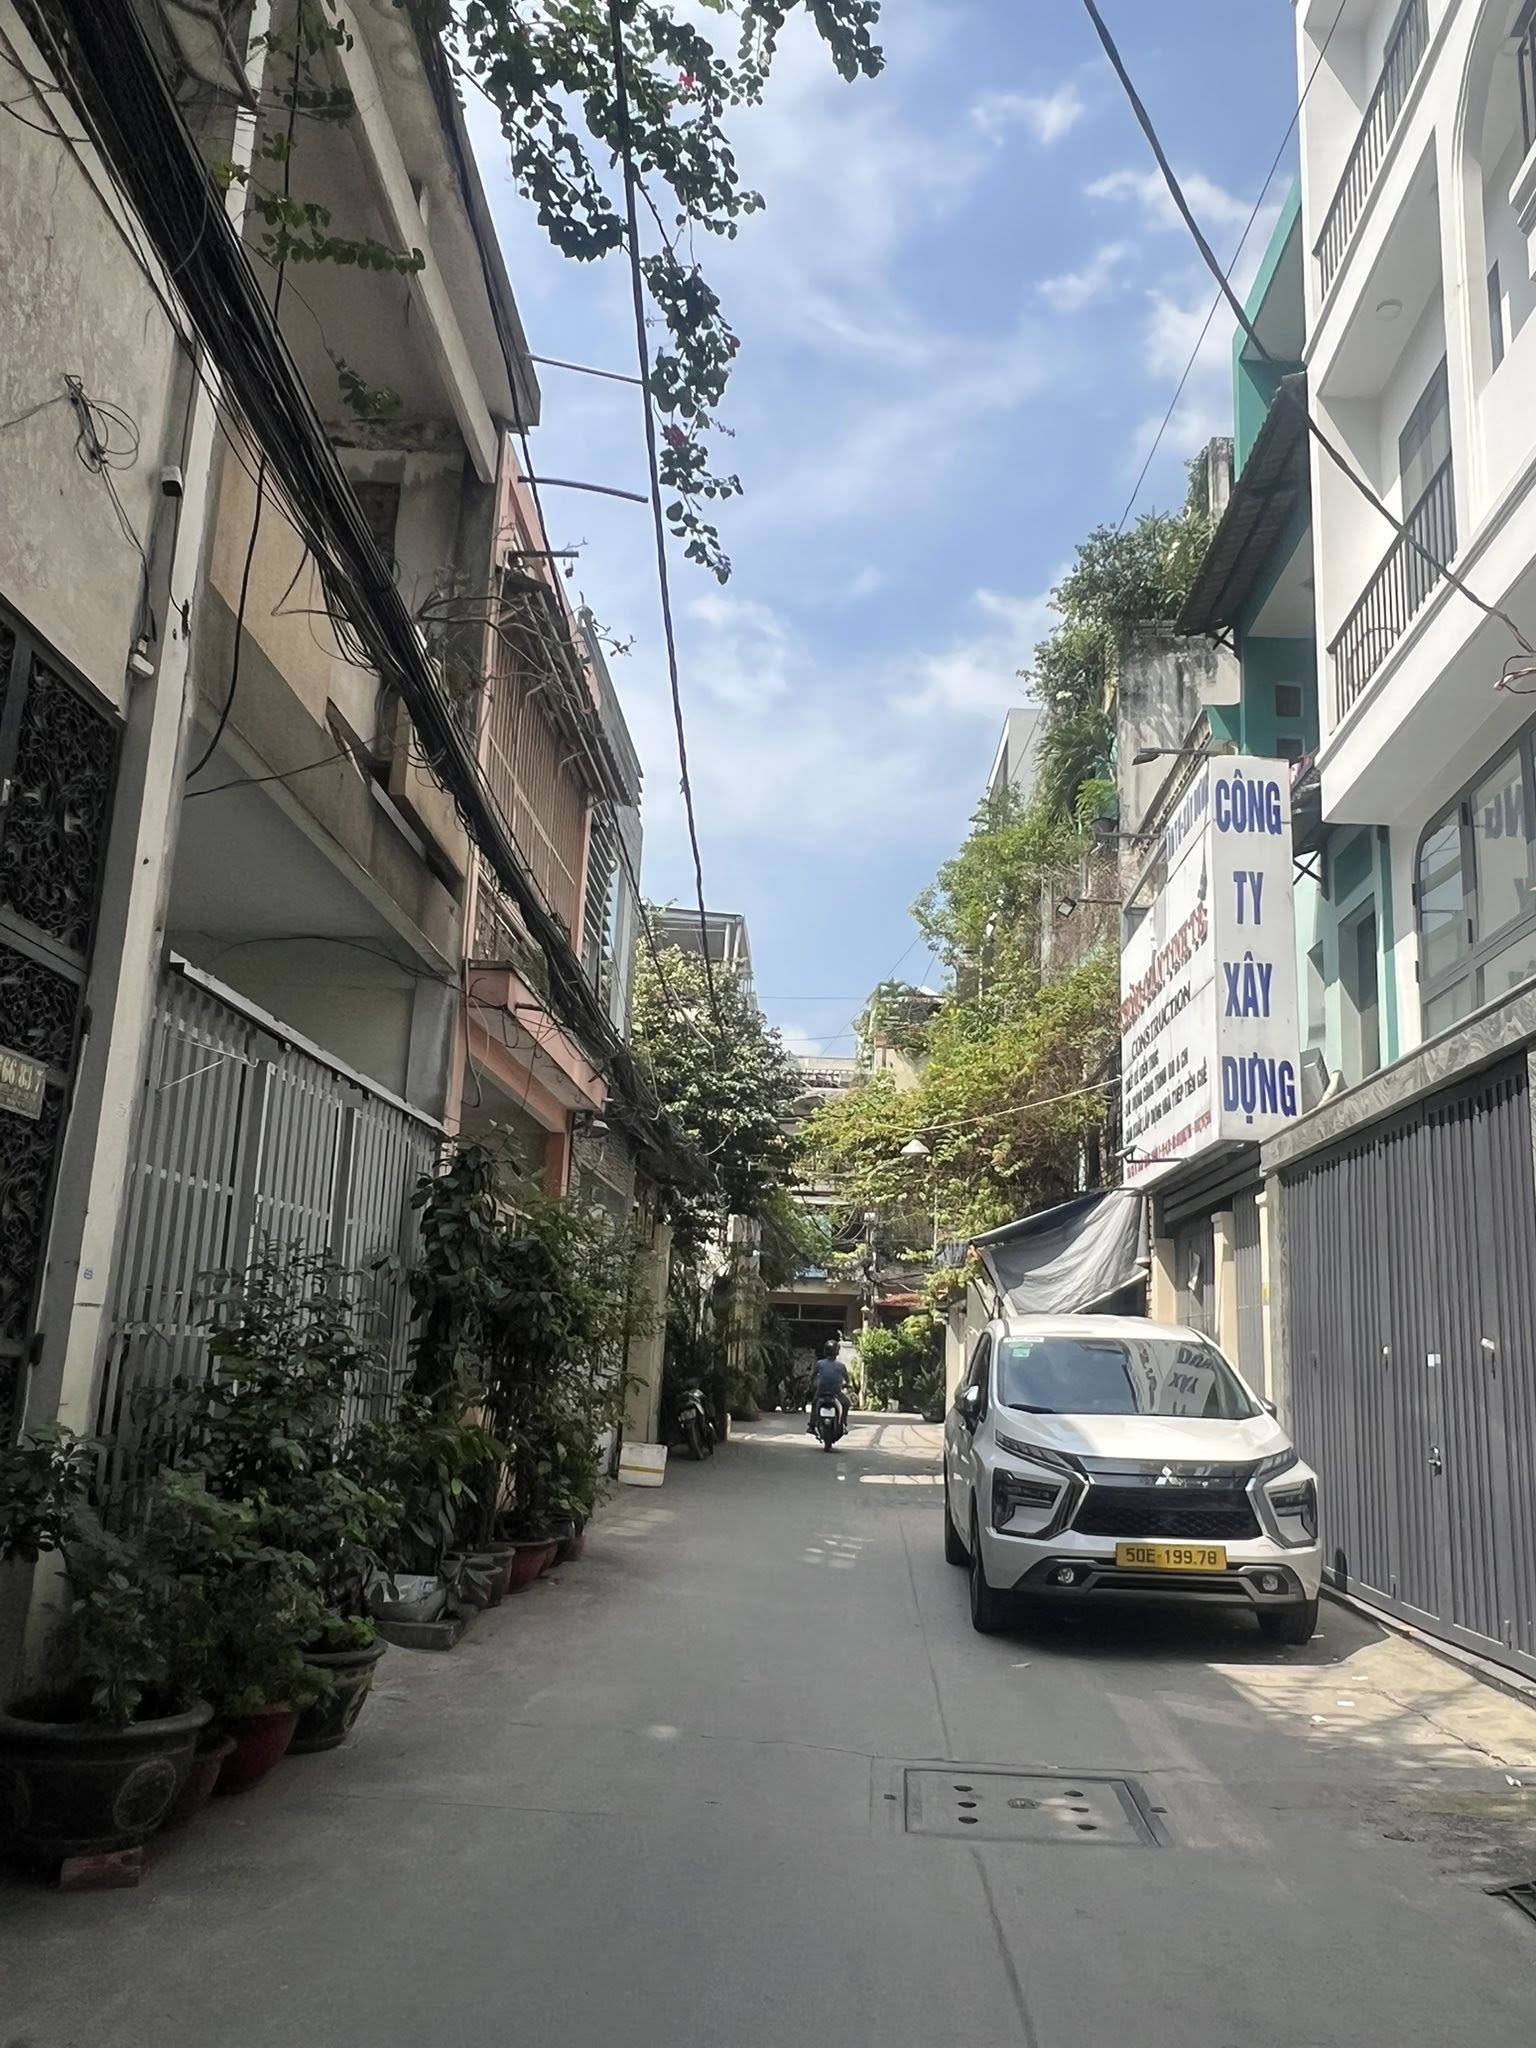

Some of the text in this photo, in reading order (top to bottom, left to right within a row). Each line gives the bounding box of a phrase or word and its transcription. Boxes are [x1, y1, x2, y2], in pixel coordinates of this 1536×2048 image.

[1215, 767, 1282, 835] CÔNG
[1232, 871, 1264, 925] TY
[1222, 949, 1273, 1018] XÂY
[1131, 980, 1191, 1061] CONSTRUCTION
[1222, 1051, 1298, 1125] DỰNG
